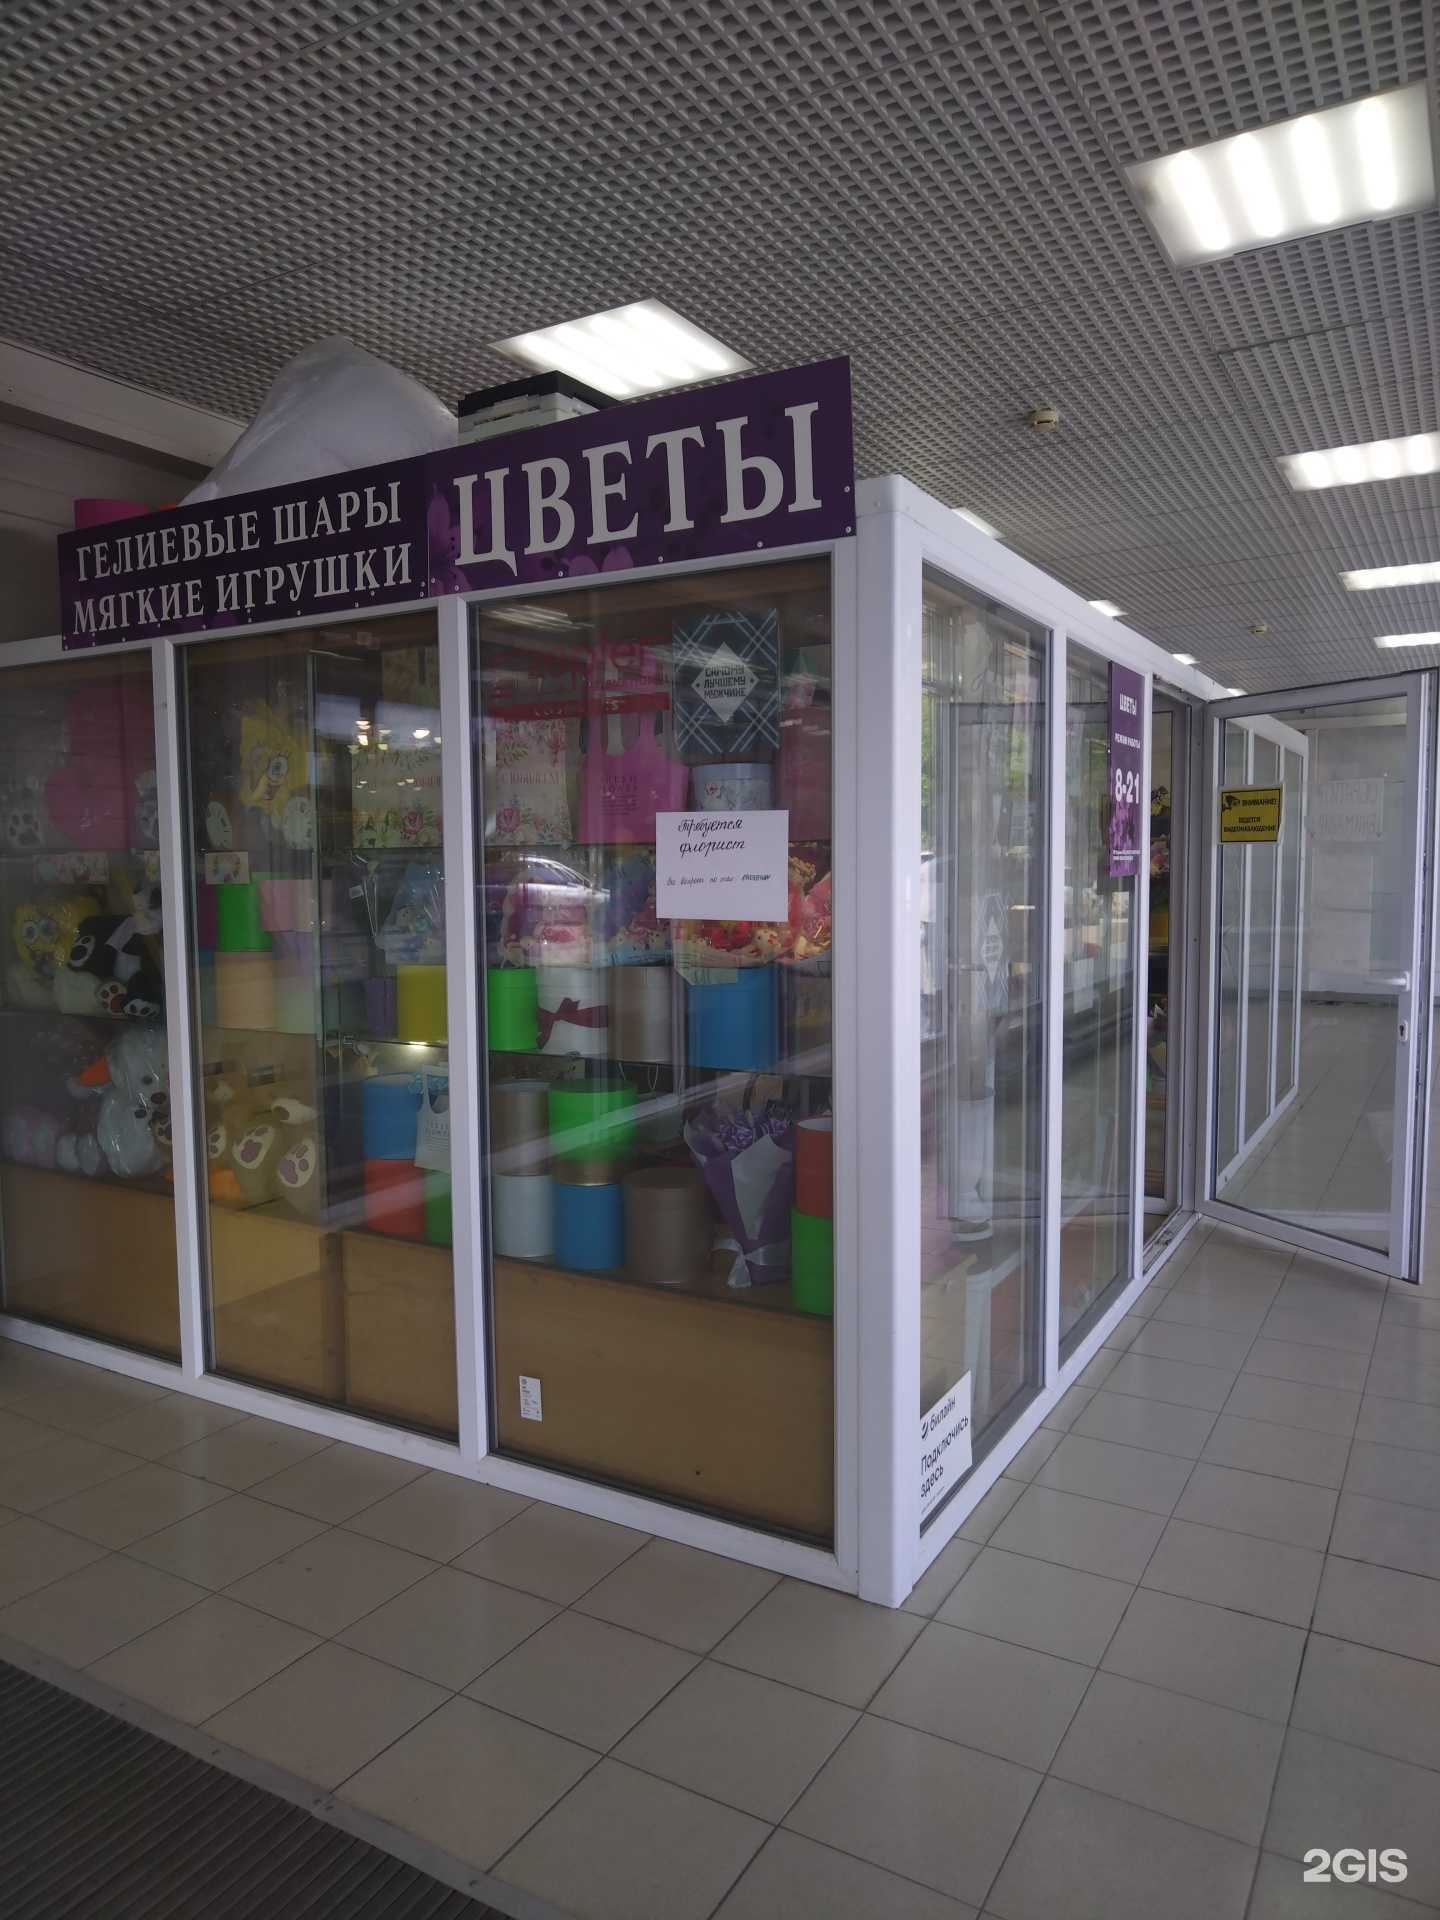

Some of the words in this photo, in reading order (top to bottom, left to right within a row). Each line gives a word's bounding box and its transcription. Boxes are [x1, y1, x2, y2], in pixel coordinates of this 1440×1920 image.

[453, 401, 823, 577] ЦВЕТЫ
[76, 511, 260, 582] ГЕЛИЕВЫЕ
[273, 481, 402, 545] ШАРЫ
[72, 579, 204, 635] МЯГКИЕ
[216, 542, 412, 614] ИГРУШКИ
[704, 664, 745, 677] САМОМУ
[704, 675, 746, 688] ЛУЧШЕМУ
[704, 687, 747, 698] МУЖЧИНЕ
[1119, 692, 1137, 716] ЦВЕТЫ
[1114, 732, 1128, 745] РЕЖИМ
[1127, 736, 1141, 749] РАБОТЫ
[1115, 768, 1140, 804] 8-21
[678, 816, 743, 837] Требуется
[921, 1416, 969, 1475] Подключись
[921, 1465, 944, 1498] здесь
